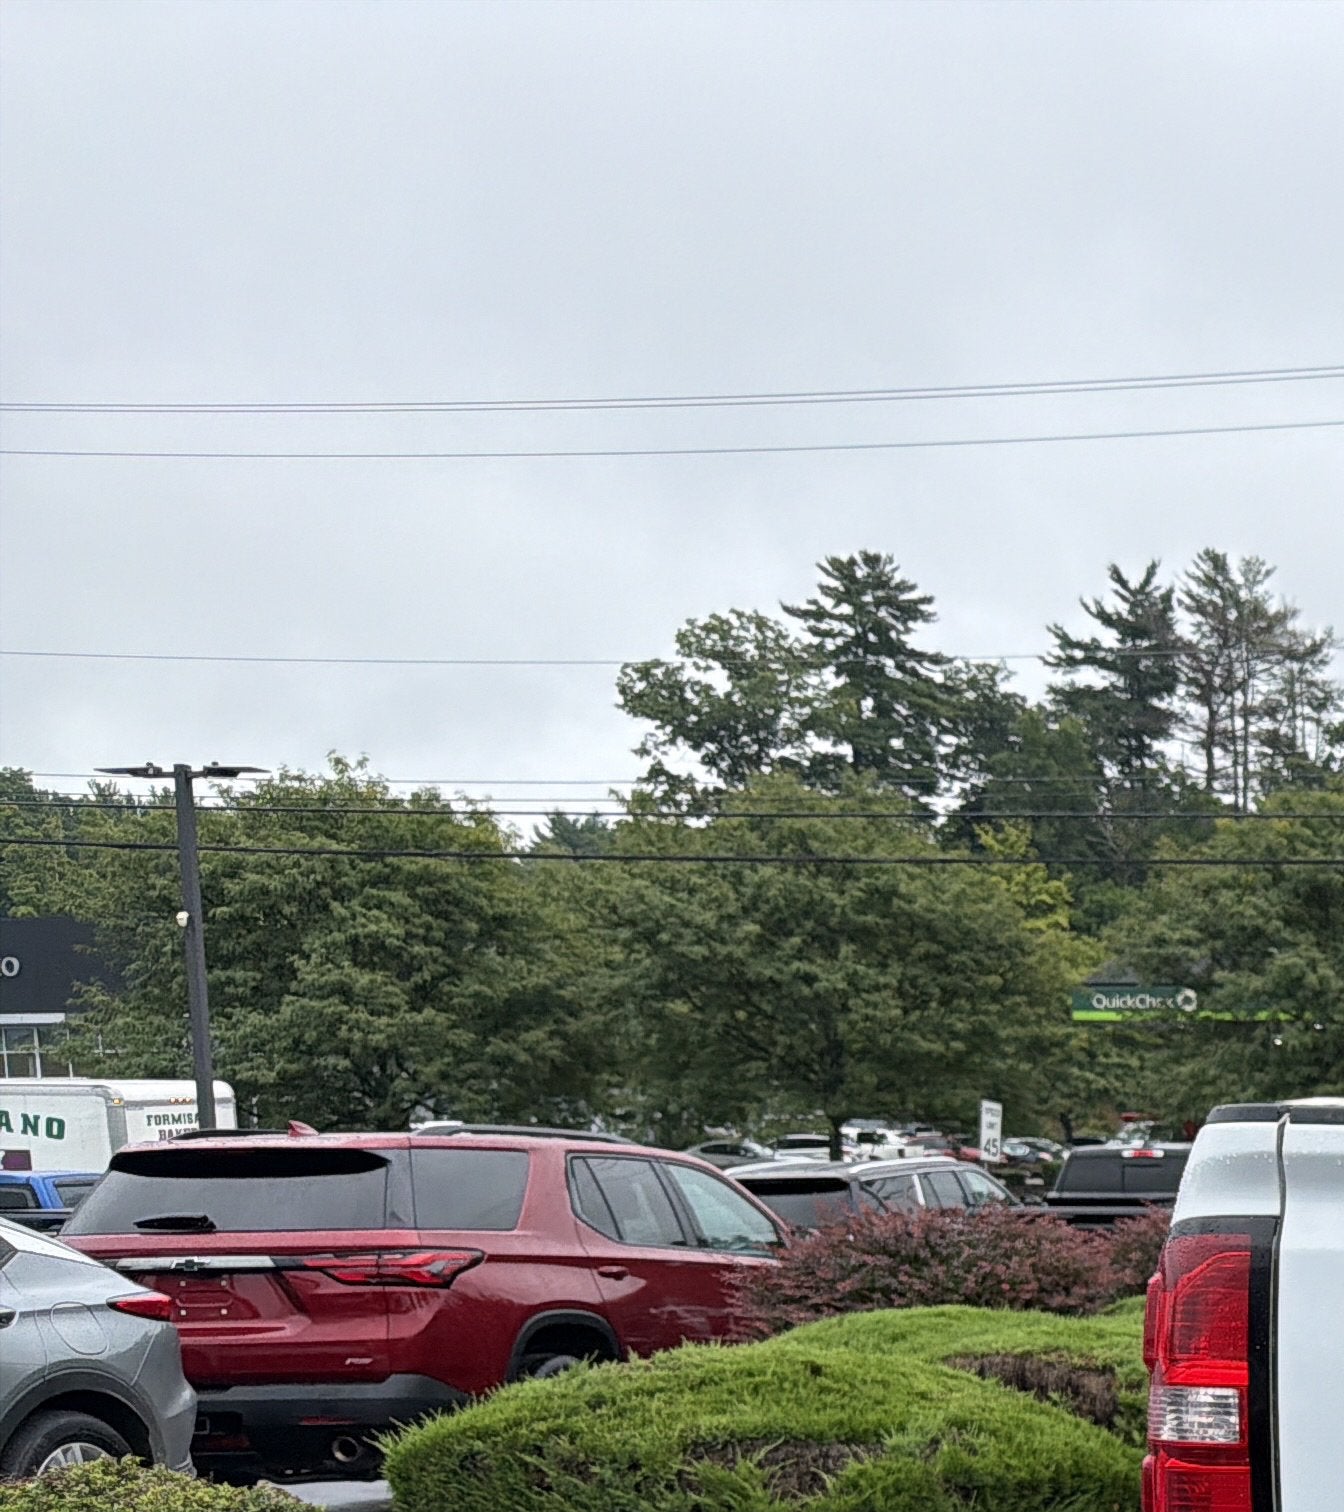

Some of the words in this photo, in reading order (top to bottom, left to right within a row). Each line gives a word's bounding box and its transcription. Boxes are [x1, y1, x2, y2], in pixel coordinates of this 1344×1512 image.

[0, 1110, 66, 1140] ANO
[146, 1112, 200, 1126] FORMISA
[983, 1137, 999, 1157] 45
